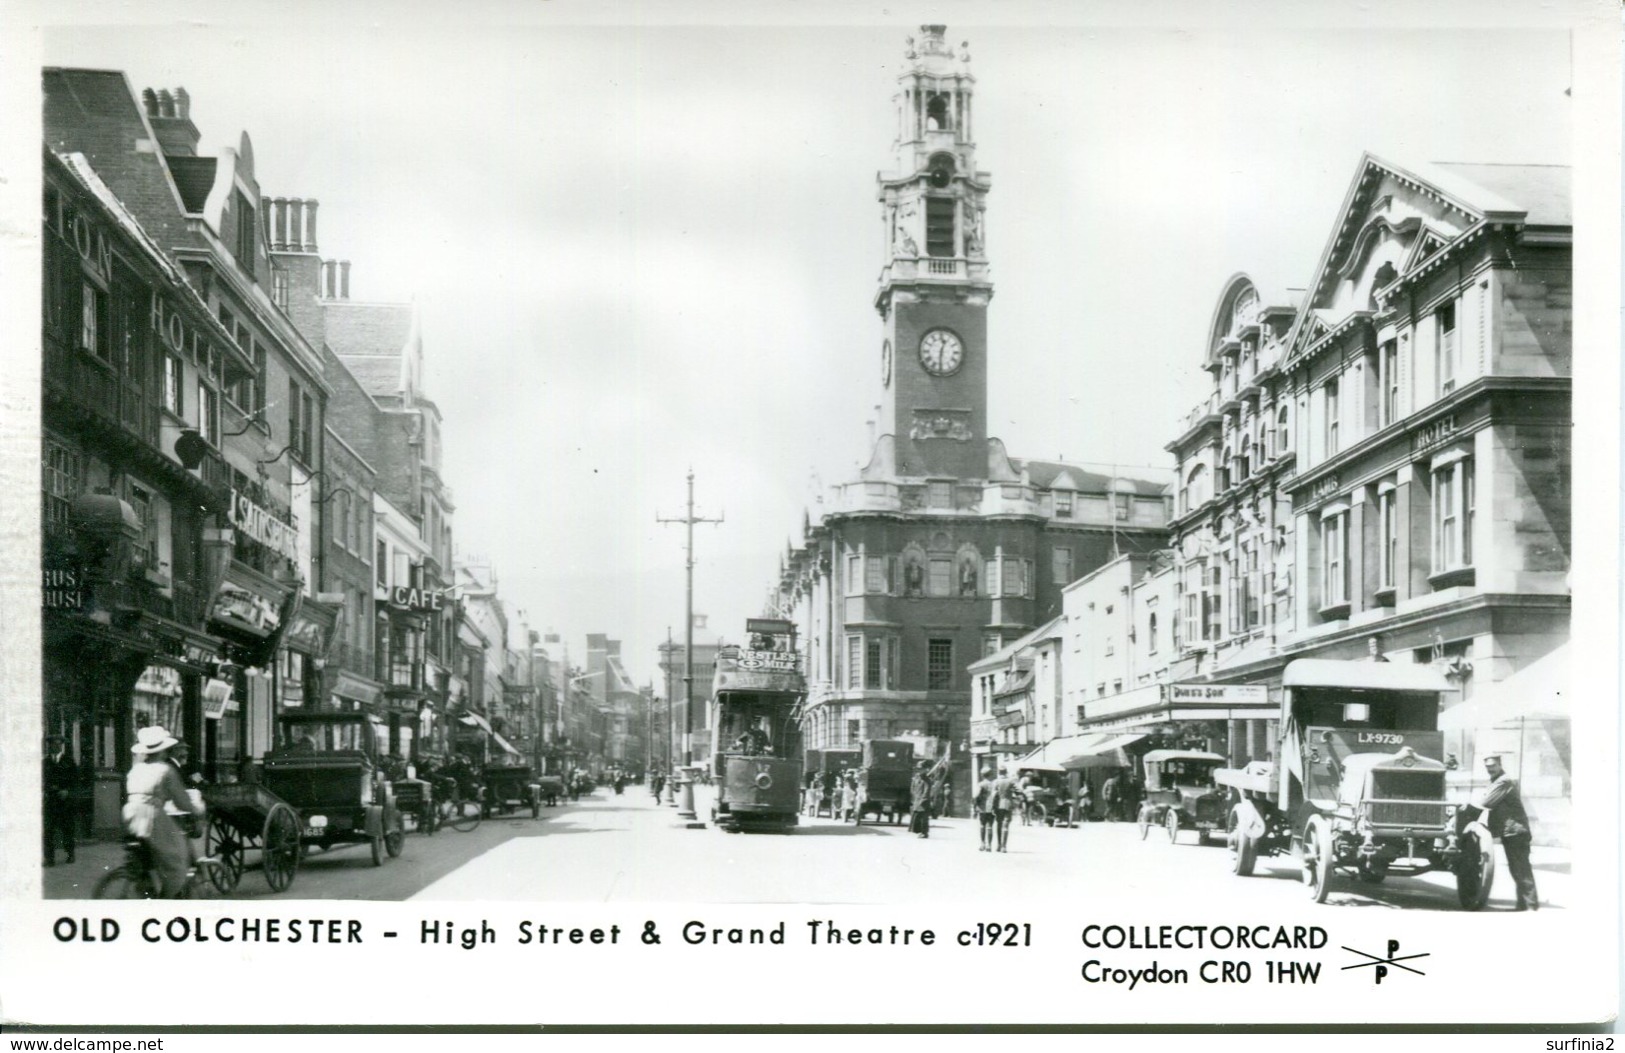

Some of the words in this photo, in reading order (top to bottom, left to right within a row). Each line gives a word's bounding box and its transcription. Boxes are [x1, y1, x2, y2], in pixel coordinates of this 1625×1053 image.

[1417, 414, 1459, 448] HOTEL
[395, 587, 442, 610] CAFE
[764, 660, 795, 670] MILK
[1358, 732, 1403, 744] LX-9730
[303, 828, 324, 836] 1685
